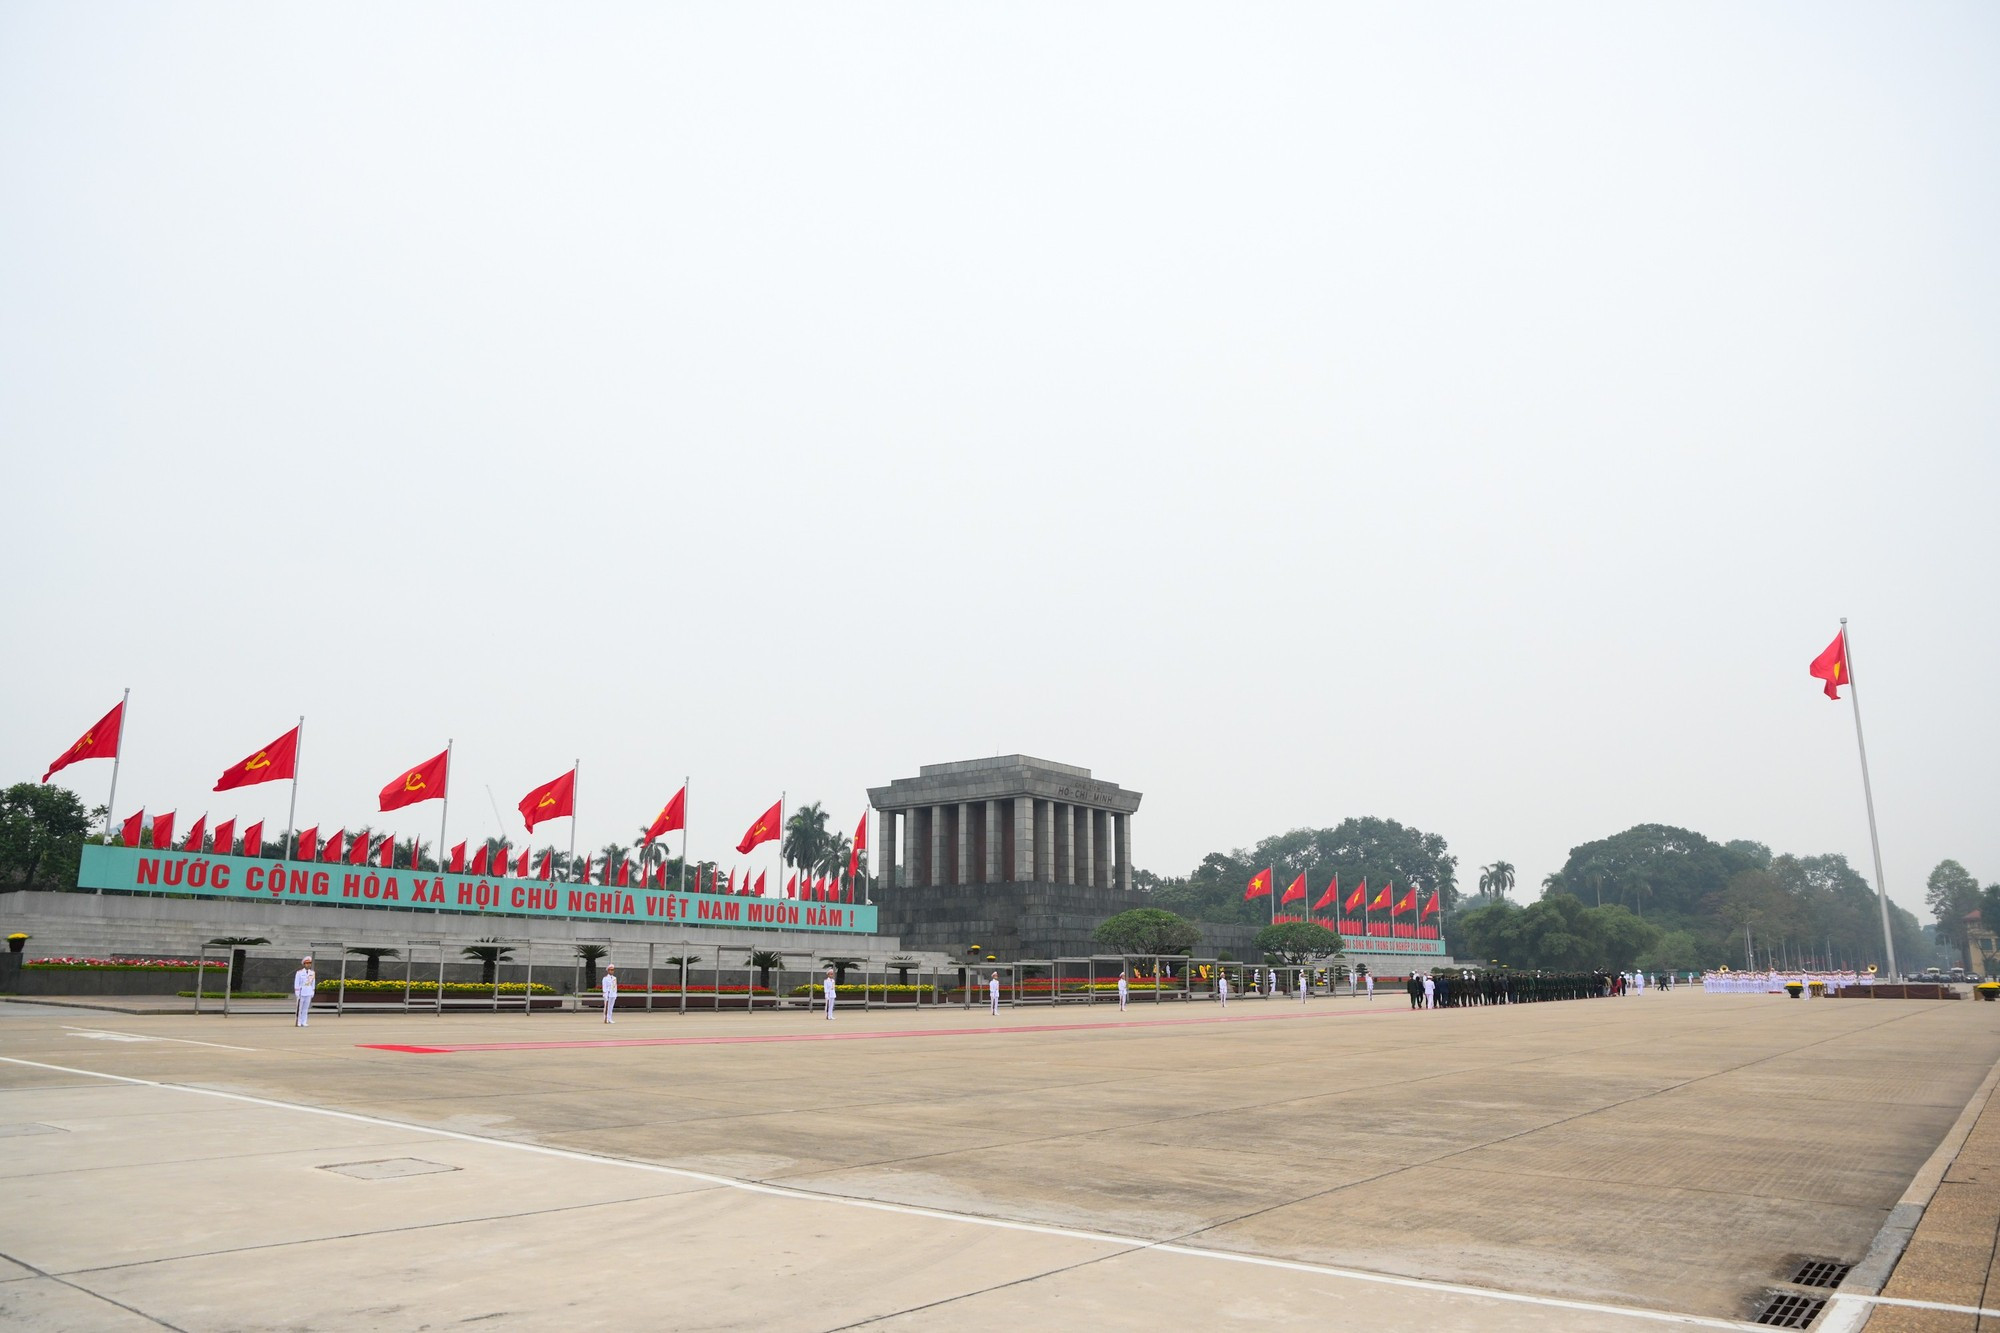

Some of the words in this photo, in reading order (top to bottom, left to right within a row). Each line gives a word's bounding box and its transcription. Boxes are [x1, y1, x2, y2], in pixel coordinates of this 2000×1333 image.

[138, 859, 229, 888] NƯỚC
[246, 864, 328, 896] CỘNG
[344, 874, 398, 900] HÒA
[412, 878, 445, 902] XÃ
[458, 880, 499, 909] HỘI
[512, 884, 557, 909] CHỦ
[568, 889, 634, 914] NGHĨA
[647, 895, 688, 920] VIỆT
[698, 901, 739, 920] NAM
[749, 903, 798, 923] MUÔN
[807, 906, 842, 925] NĂM
